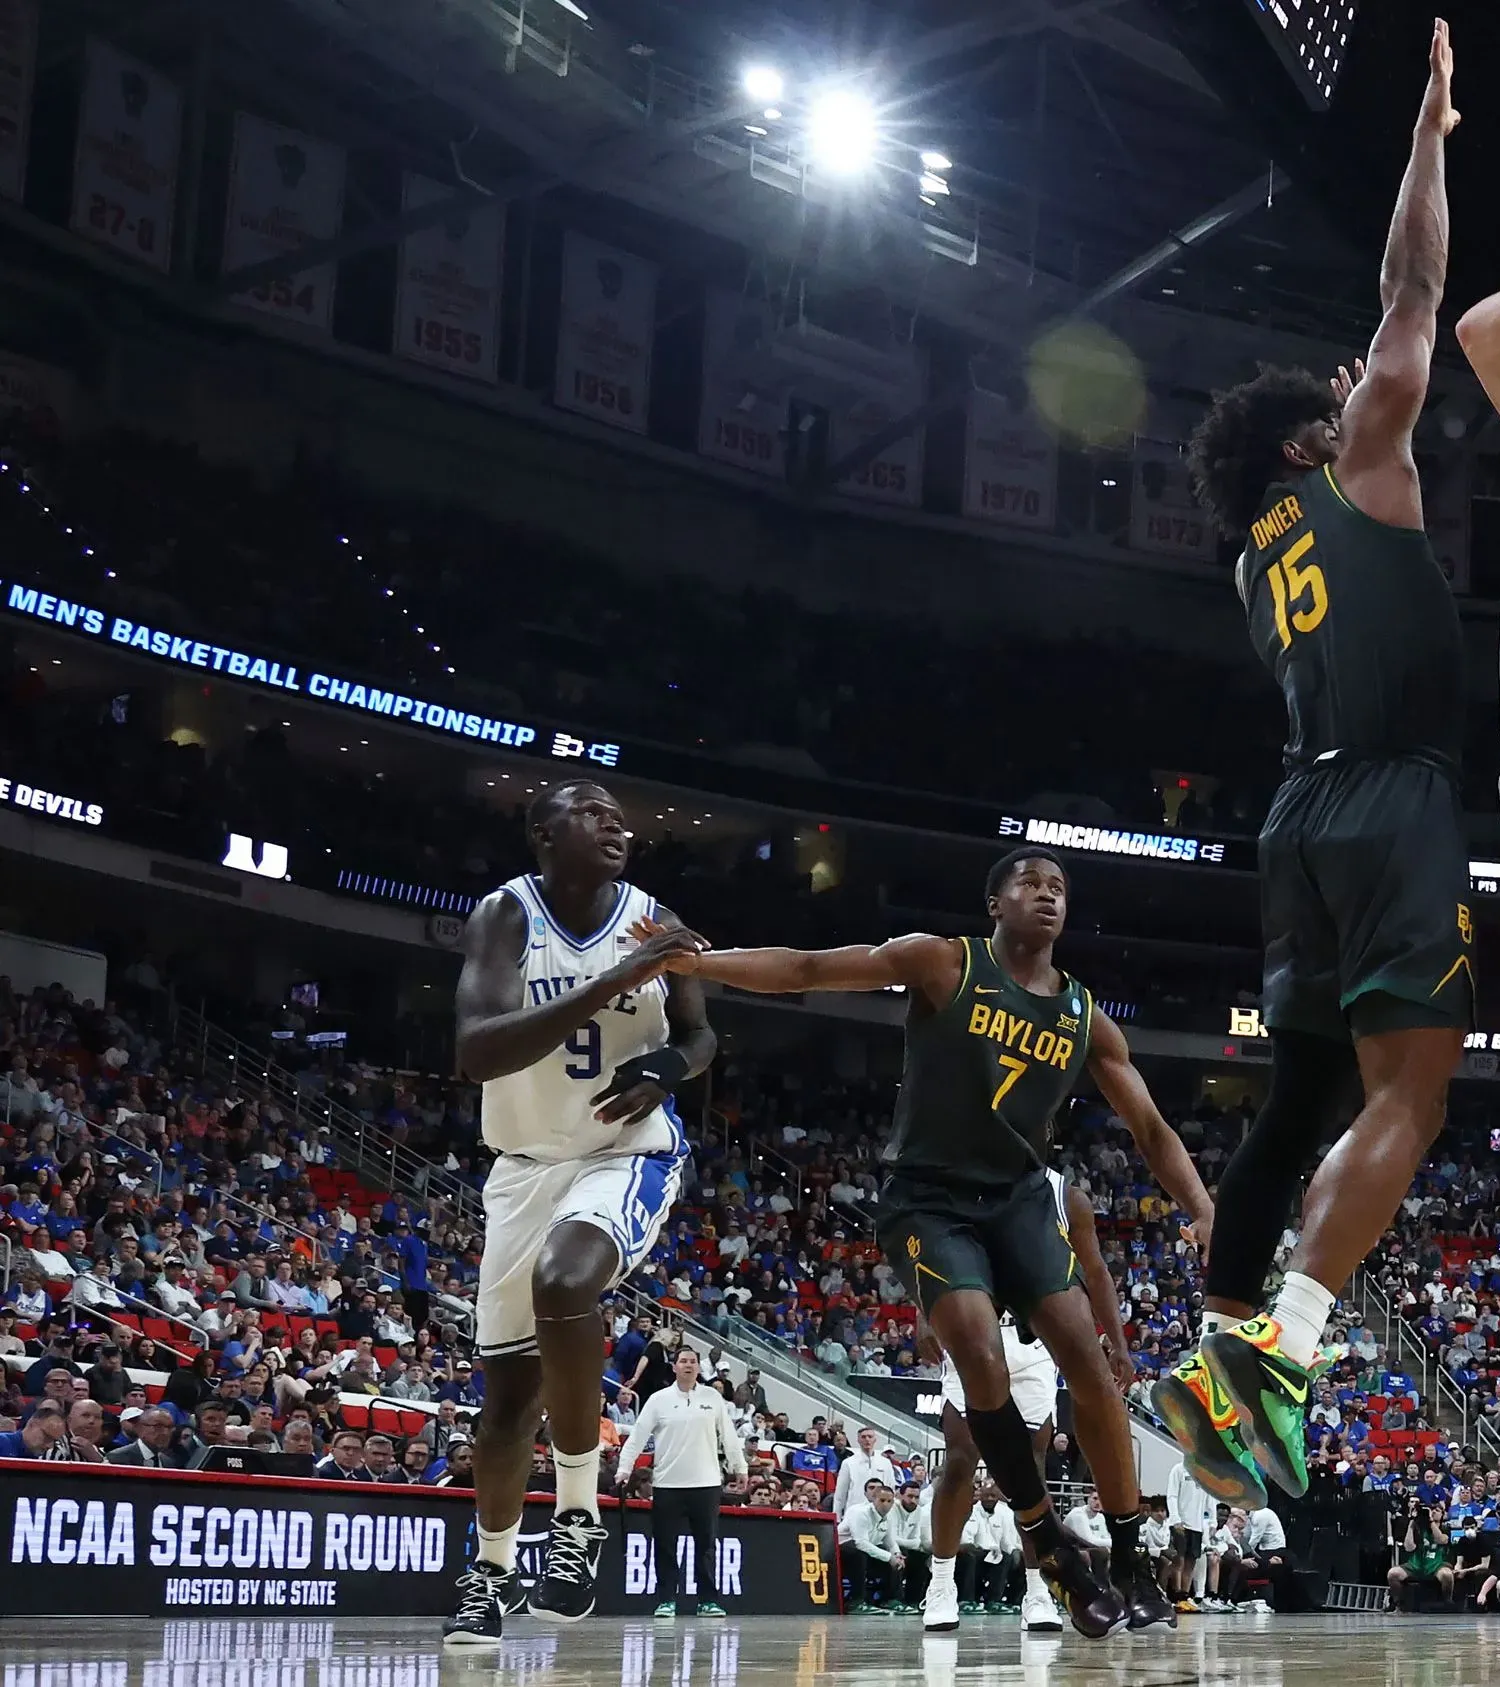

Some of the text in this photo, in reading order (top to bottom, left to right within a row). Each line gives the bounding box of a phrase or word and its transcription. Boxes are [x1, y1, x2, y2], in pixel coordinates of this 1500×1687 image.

[1251, 495, 1303, 550] OMIER
[1267, 530, 1328, 649] 15
[9, 584, 535, 747] MEN'S BASKETBALL CHAMPIONSHIP
[15, 784, 104, 825] DEVILS
[1025, 819, 1198, 860] MARCHMADNESS
[565, 1020, 601, 1079] 9
[968, 1003, 1074, 1071] BAYLOR
[991, 1054, 1029, 1111] 7
[11, 1497, 446, 1573] NCAA SECOND ROUND
[166, 1578, 336, 1606] HOSTED BY NC STATE
[799, 1534, 829, 1603] BU
